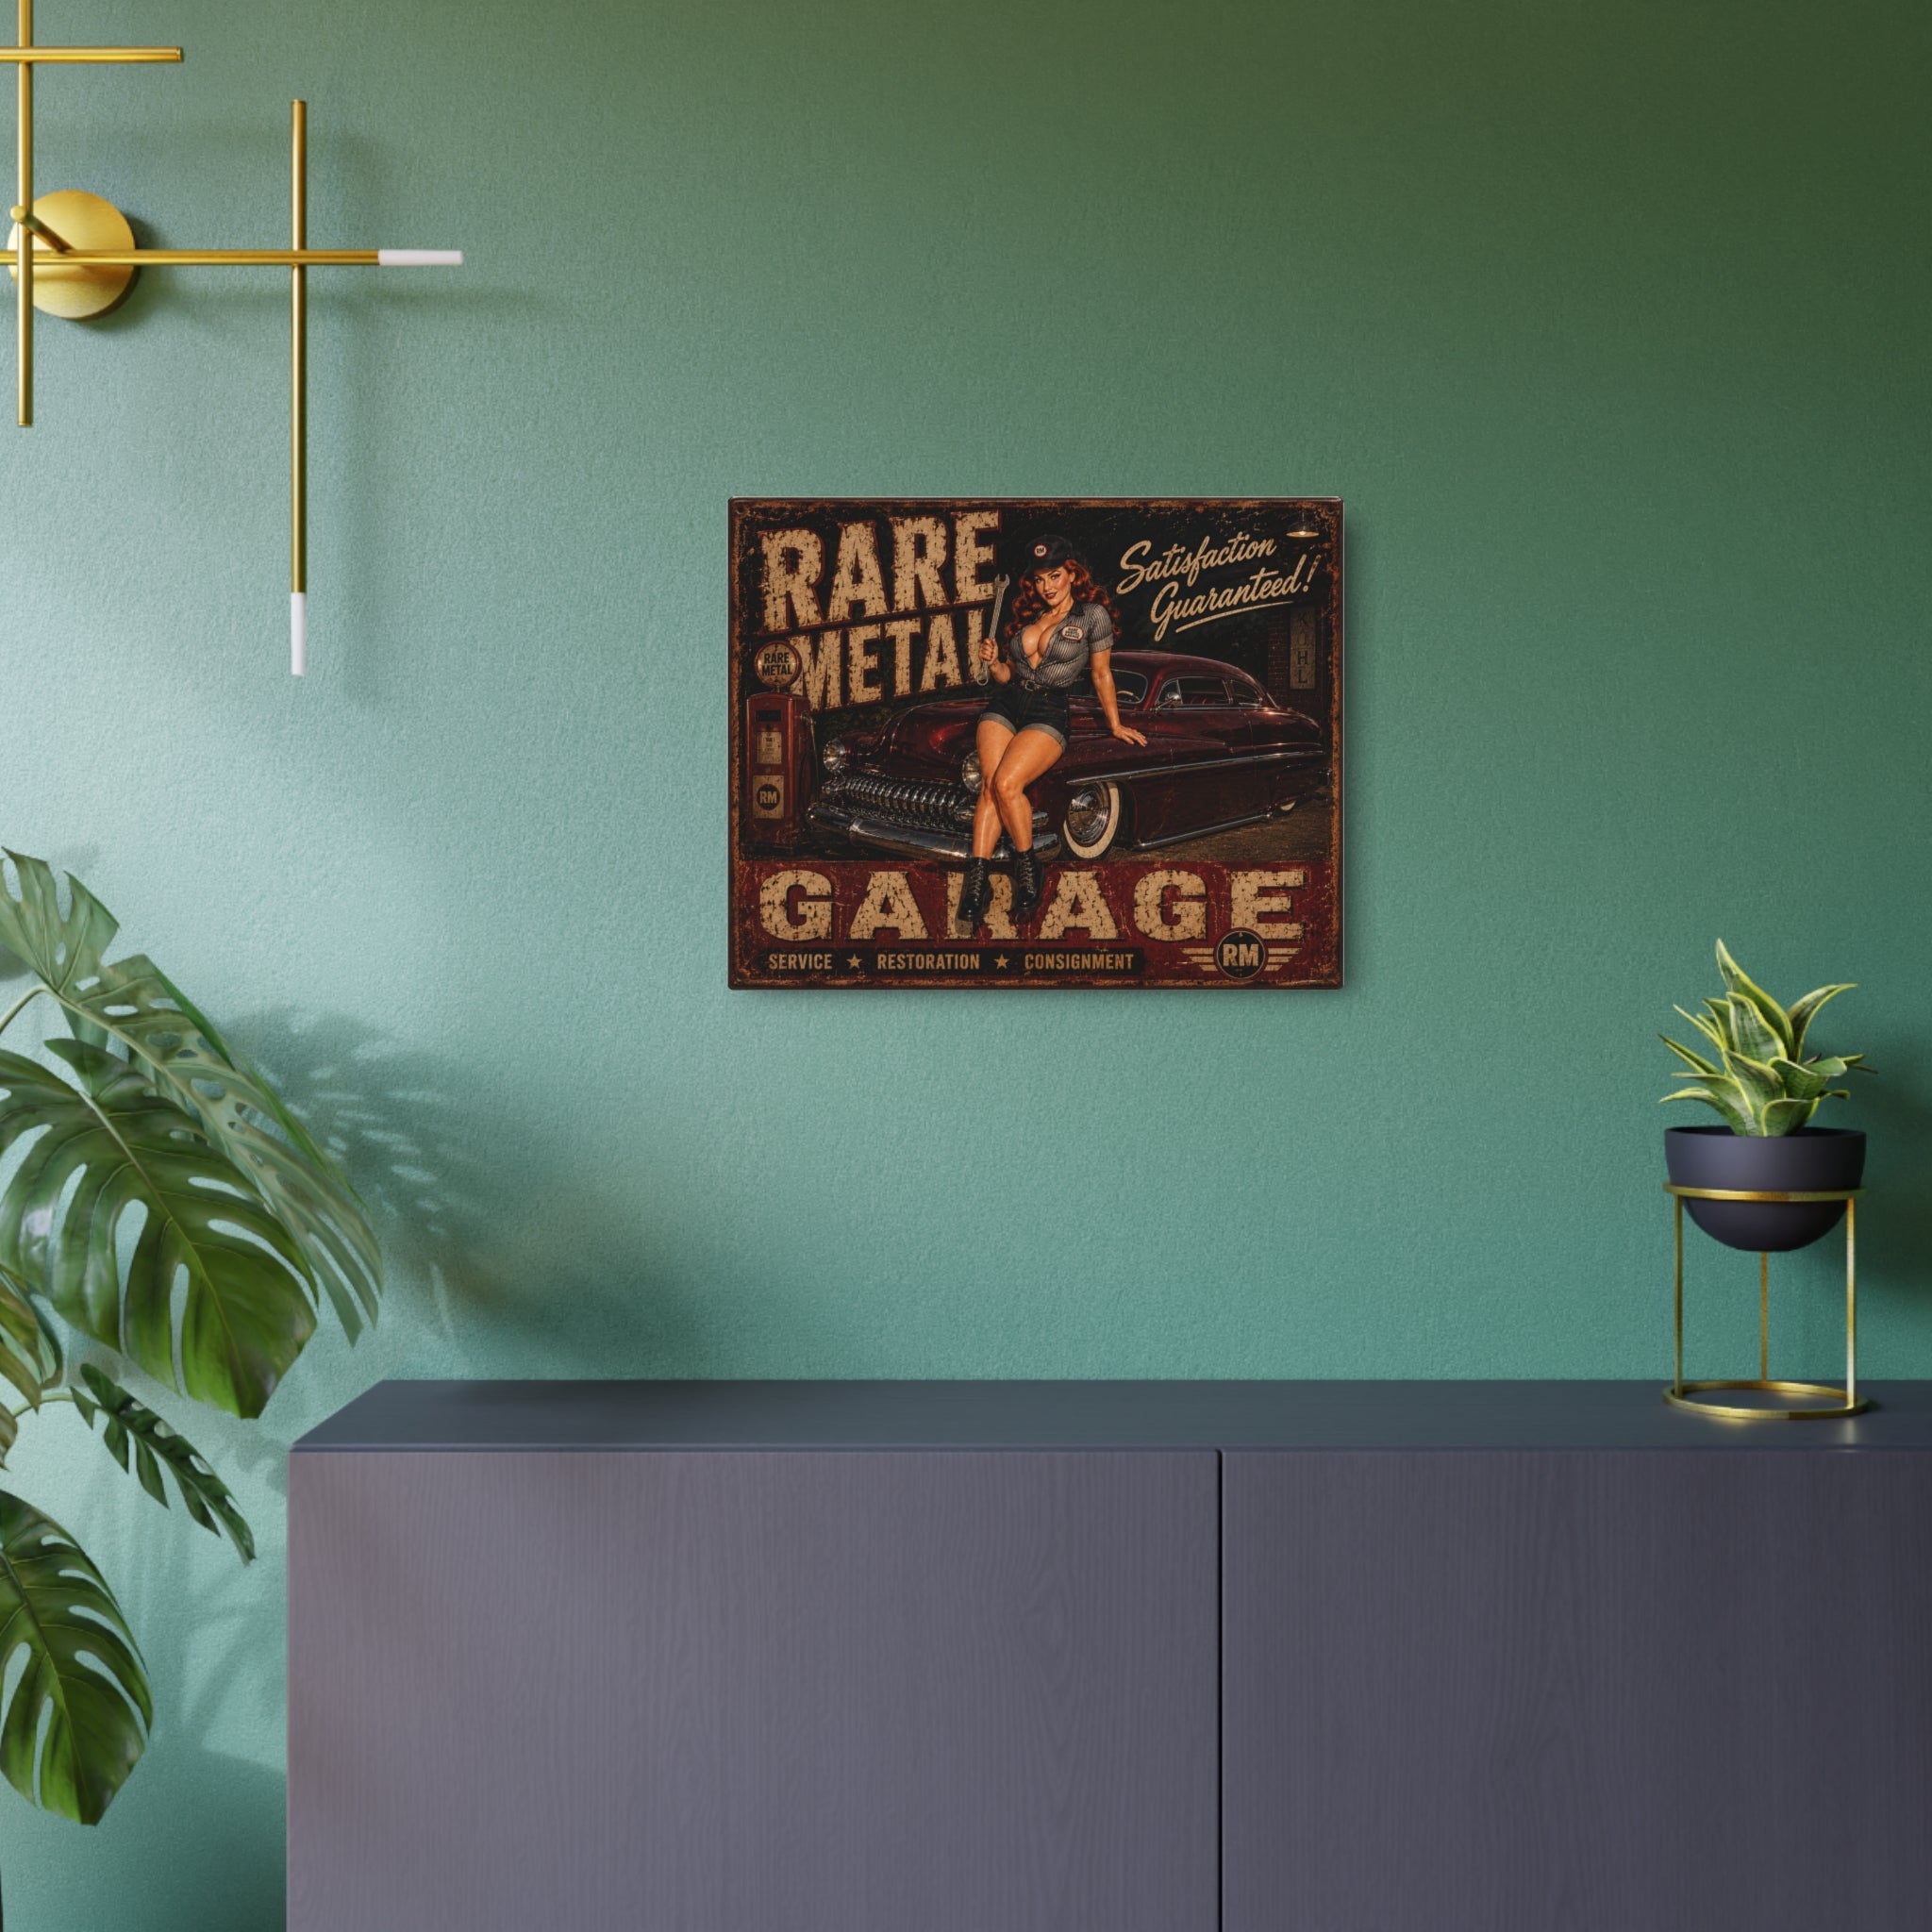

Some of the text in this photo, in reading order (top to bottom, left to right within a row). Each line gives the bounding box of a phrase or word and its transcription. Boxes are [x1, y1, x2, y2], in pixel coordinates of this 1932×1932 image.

[759, 510, 1000, 633] RARE
[1116, 531, 1277, 595] Satisfaction
[1150, 554, 1321, 641] Guaranteed!
[761, 664, 793, 676] METAL
[763, 652, 790, 664] RARE
[758, 791, 777, 804] RM
[759, 869, 1305, 941] GARAGE
[769, 953, 1134, 970] SERVICE RESTORATION CONSIGNMENT
[1223, 943, 1259, 967] RM
